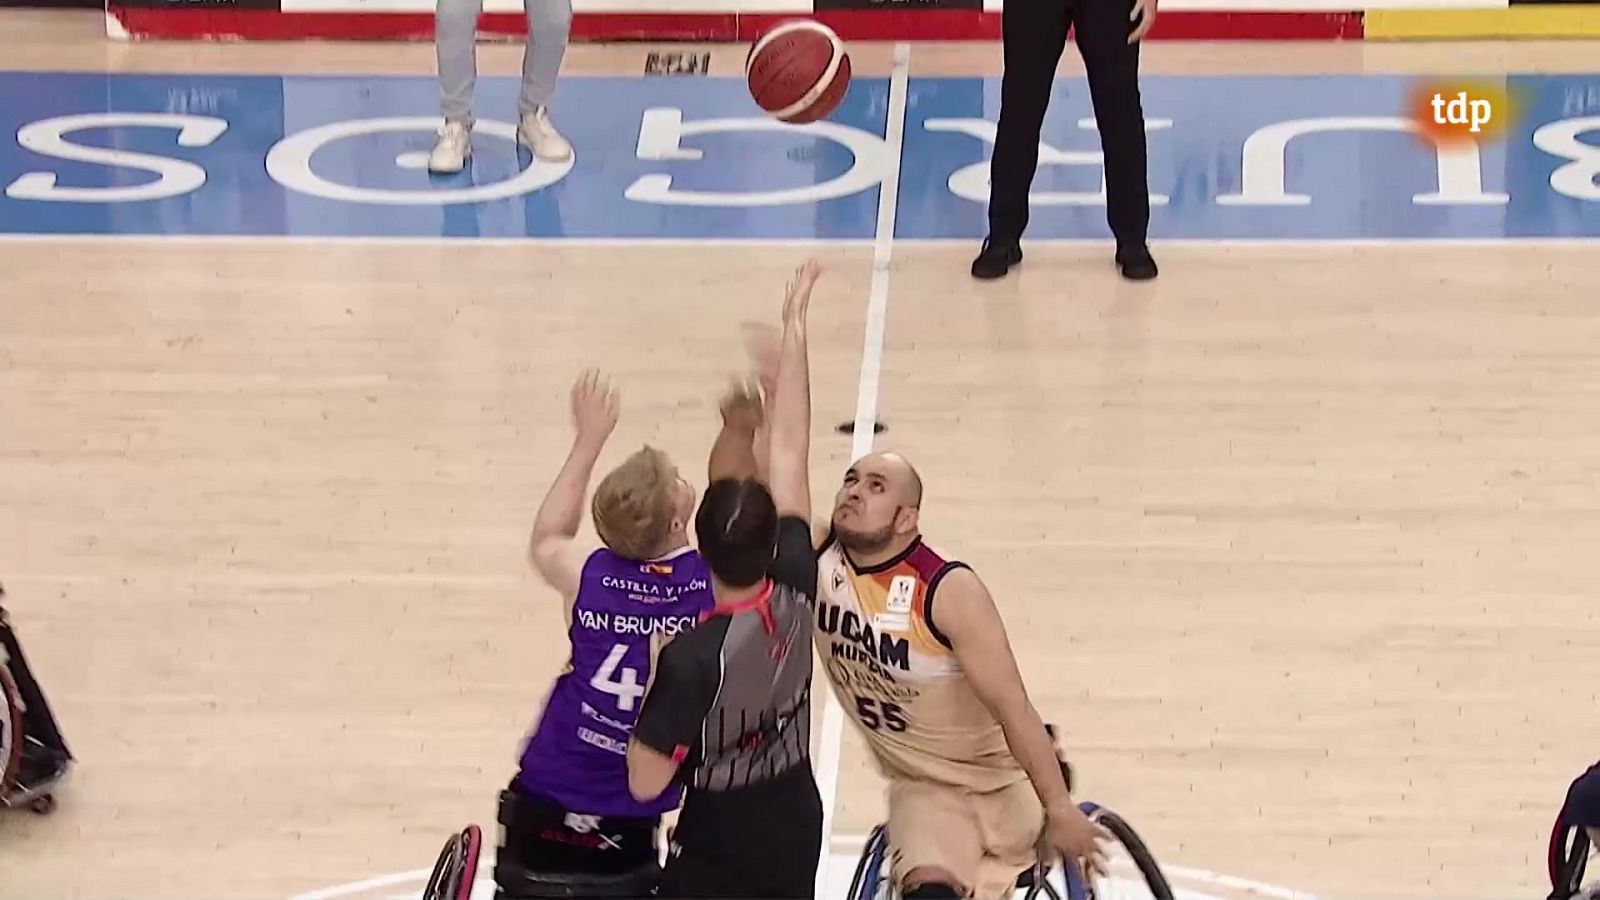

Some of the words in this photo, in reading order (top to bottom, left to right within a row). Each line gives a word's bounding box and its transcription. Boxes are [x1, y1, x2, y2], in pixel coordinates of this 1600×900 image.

[602, 576, 659, 595] CASTILLA
[665, 586, 675, 597] Y
[578, 609, 608, 631] VAN
[818, 601, 910, 671] UCAM
[590, 643, 645, 711] 4
[855, 696, 907, 732] 55
